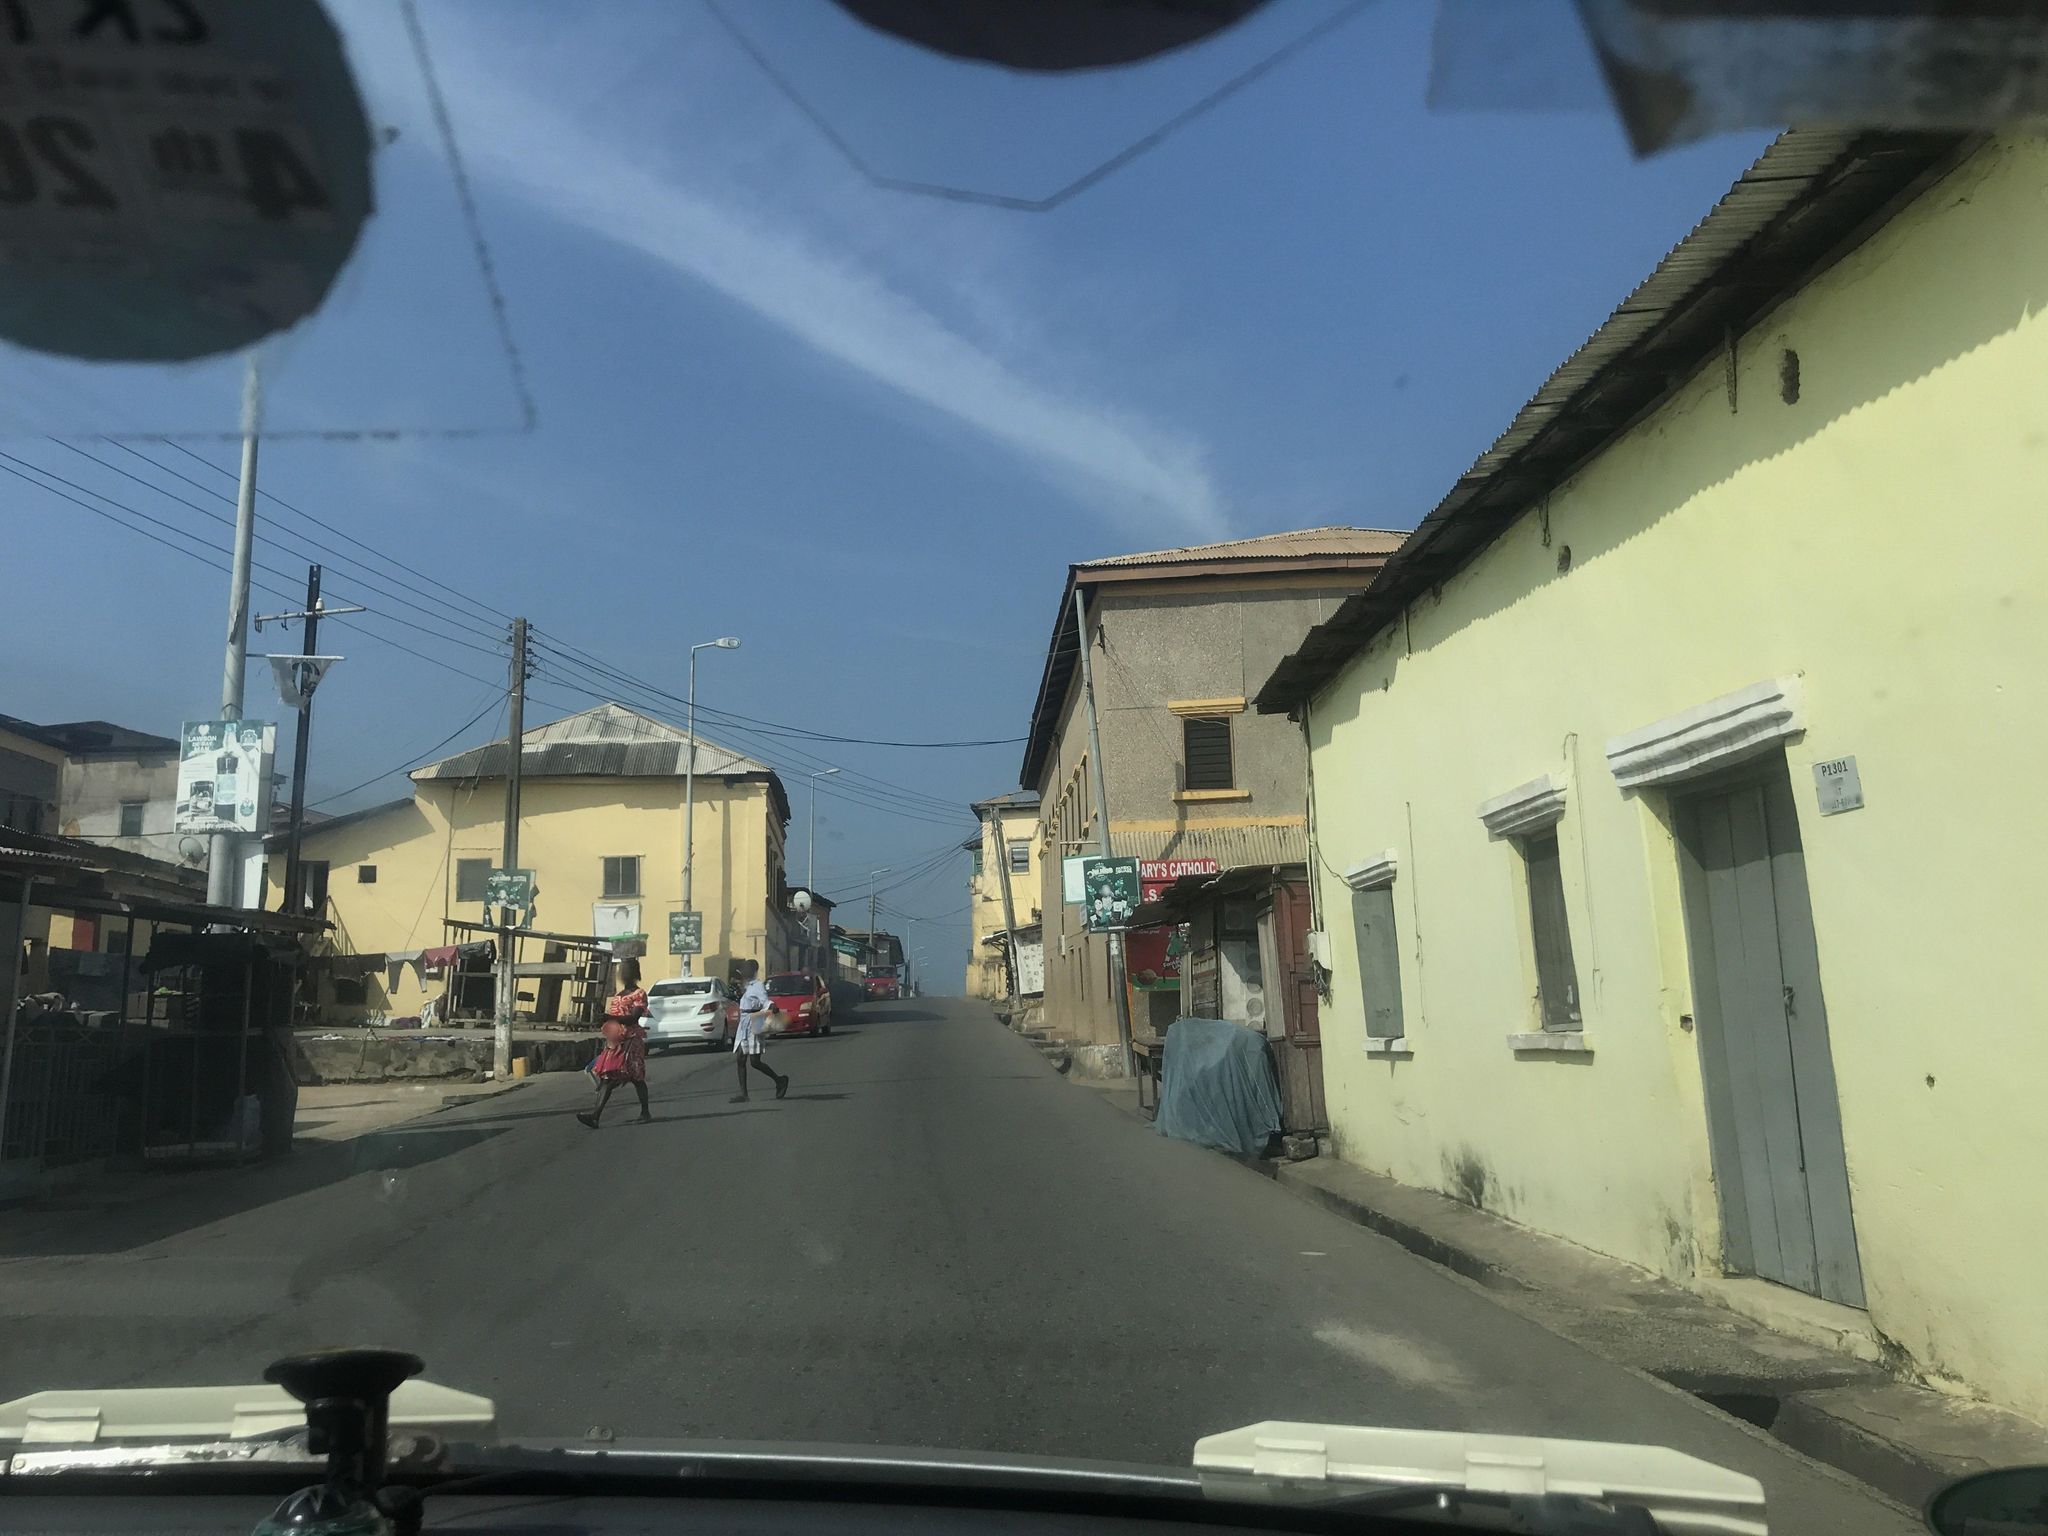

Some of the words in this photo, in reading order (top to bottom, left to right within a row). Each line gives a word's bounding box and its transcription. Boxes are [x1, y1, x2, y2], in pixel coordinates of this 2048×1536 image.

[1821, 760, 1848, 777] P1301
[1141, 863, 1168, 878] ARY'S
[1169, 861, 1216, 877] CATHOLIC
